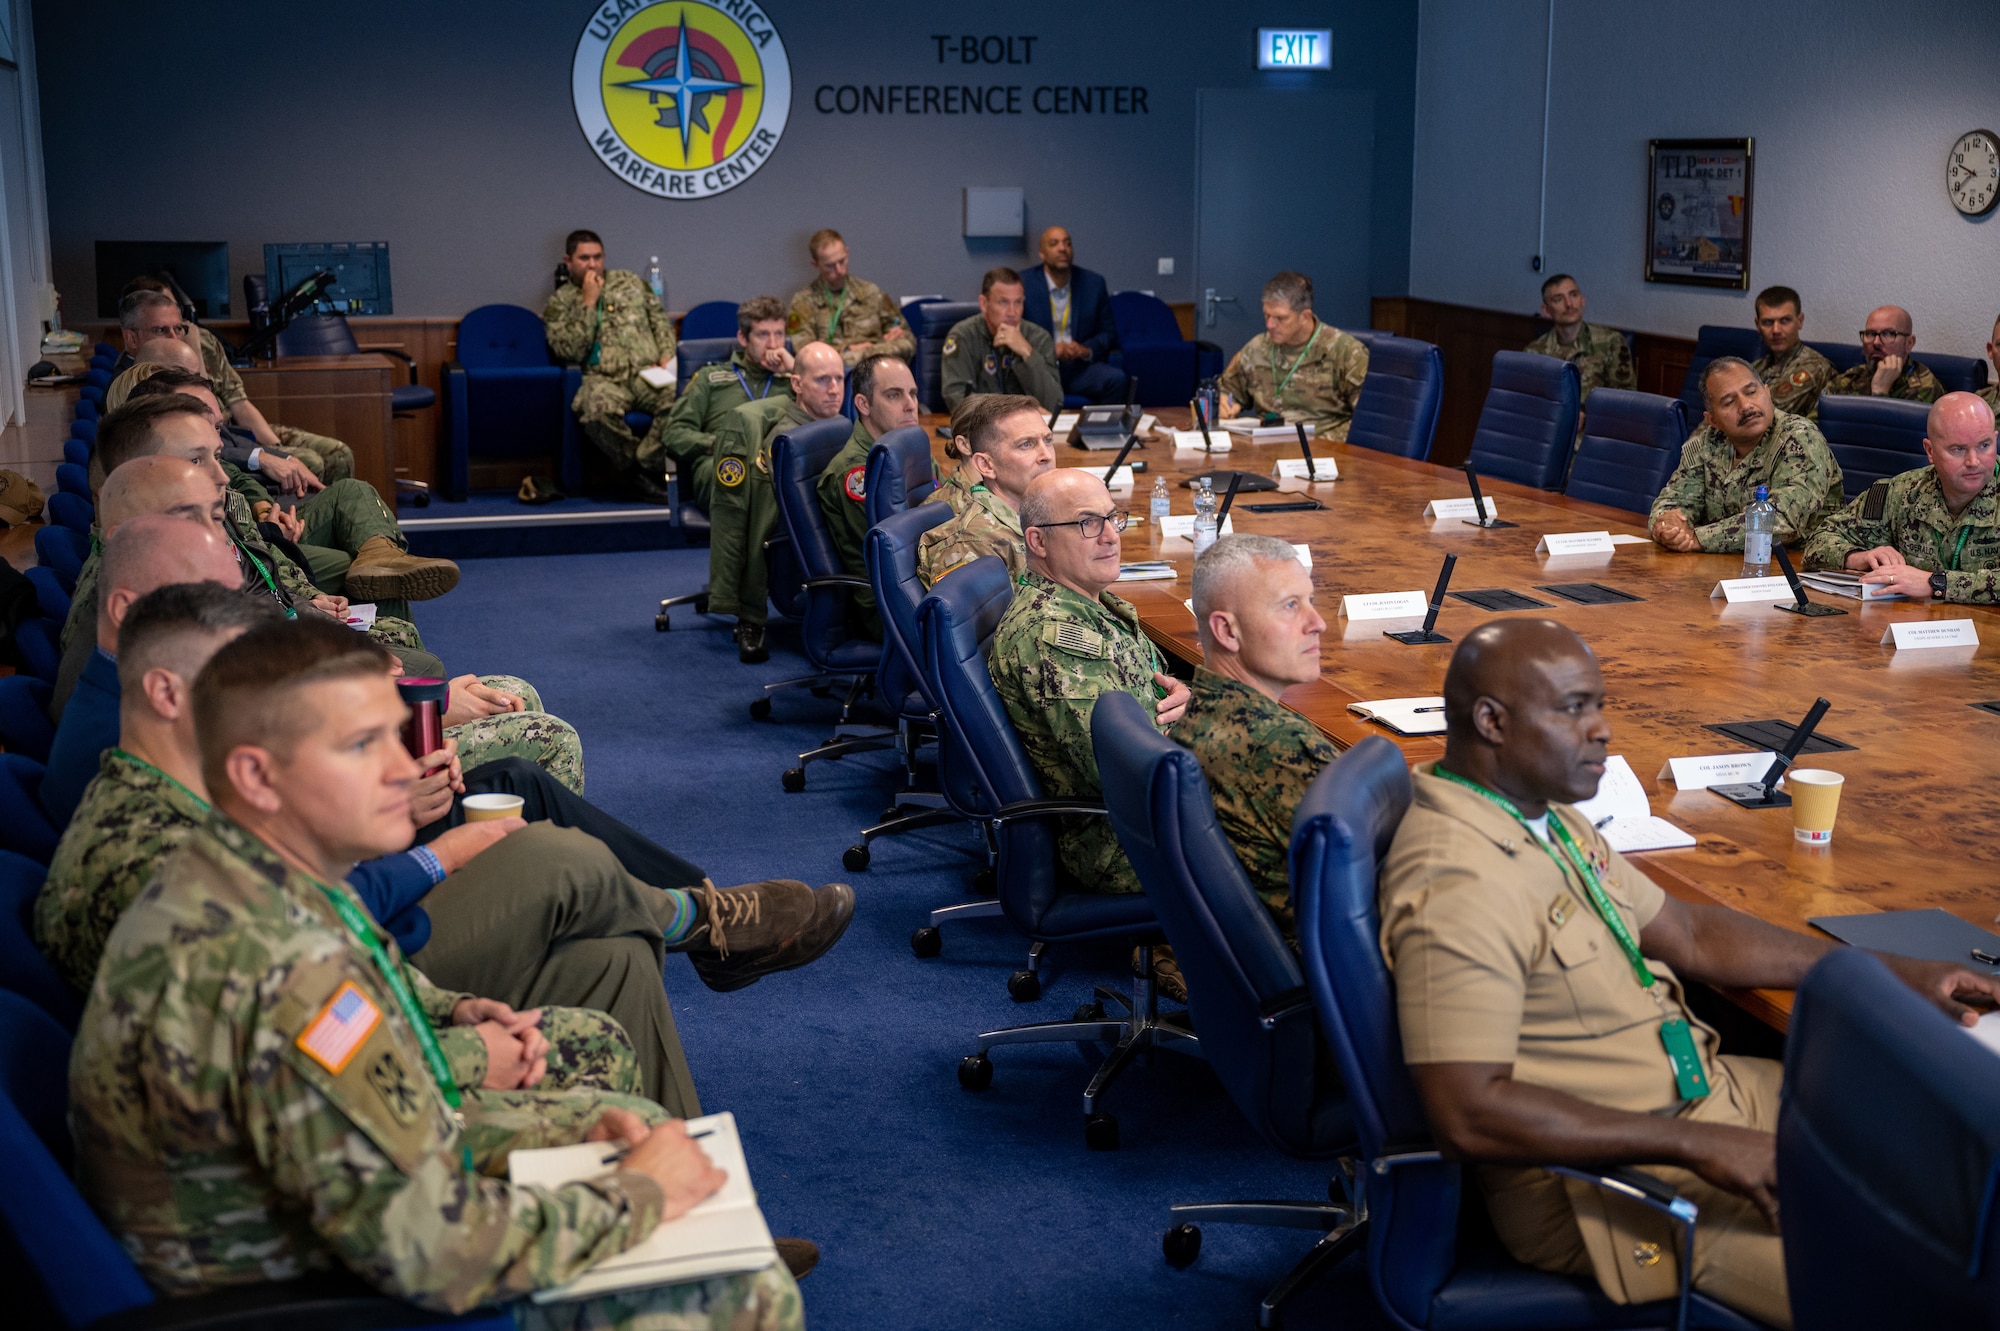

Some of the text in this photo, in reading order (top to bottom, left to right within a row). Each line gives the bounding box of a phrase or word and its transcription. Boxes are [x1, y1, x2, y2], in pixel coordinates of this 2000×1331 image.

[932, 35, 1038, 64] T-BOLT
[1272, 34, 1318, 64] EXIT
[815, 85, 1149, 115] CONFERENCE CENTER
[1964, 142, 1970, 152] 11
[1972, 138, 1980, 148] 12
[596, 127, 776, 194] WARFARE CENTER
[1955, 154, 1964, 163] 10
[1989, 153, 1995, 164] 2
[1661, 155, 1697, 178] TLP
[1952, 167, 1958, 177] 9
[1991, 168, 1996, 178] 3
[1954, 181, 1960, 191] 8
[1986, 183, 1992, 192] 4
[1961, 192, 1966, 202] 7
[1969, 197, 1975, 206] 6
[1979, 193, 1984, 203] 5
[1985, 547, 2000, 556] NAV
